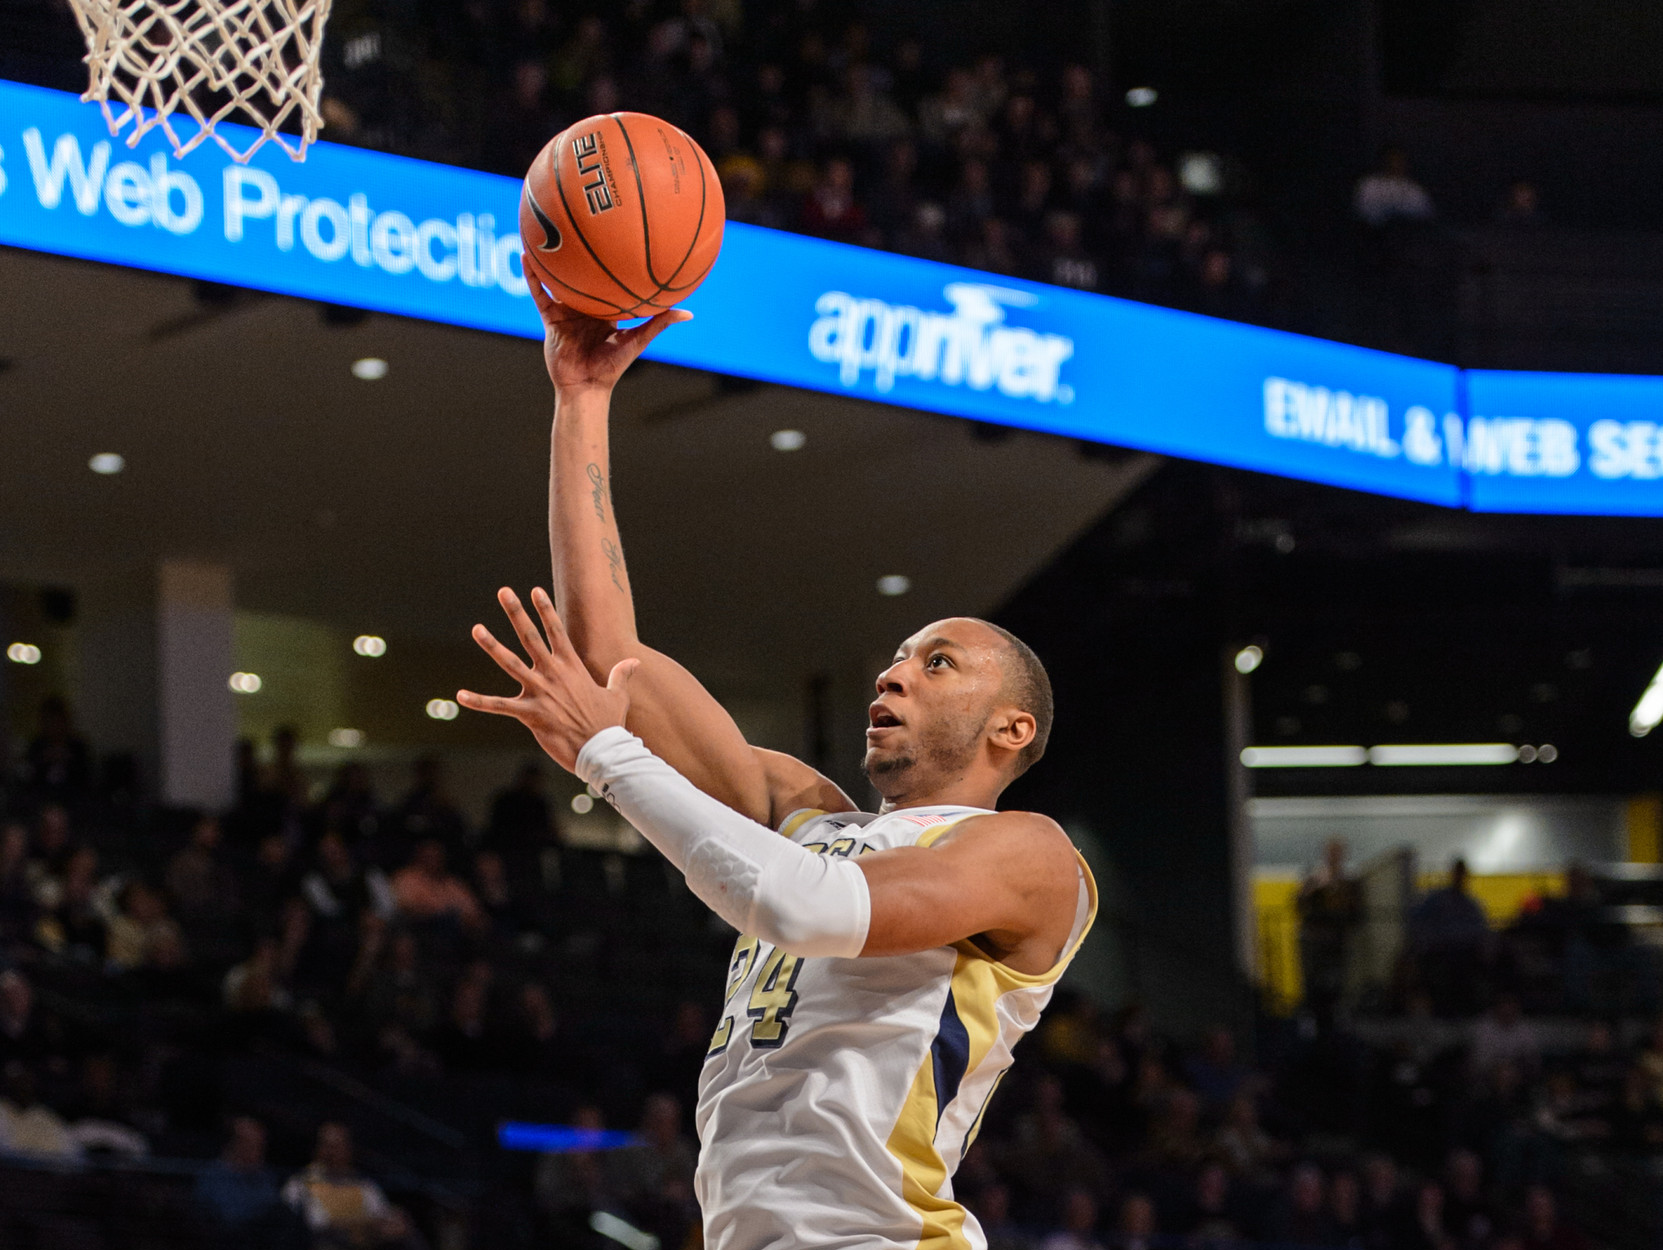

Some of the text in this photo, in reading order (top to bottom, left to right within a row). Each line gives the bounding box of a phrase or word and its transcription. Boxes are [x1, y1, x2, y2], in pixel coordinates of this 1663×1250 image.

[22, 127, 204, 235] Web
[222, 164, 527, 296] Protectio
[572, 132, 615, 216] ELITE
[1263, 376, 1400, 458] EMAIL
[1403, 405, 1443, 466] &
[1443, 411, 1581, 477] WEB
[704, 932, 804, 1059] 24
